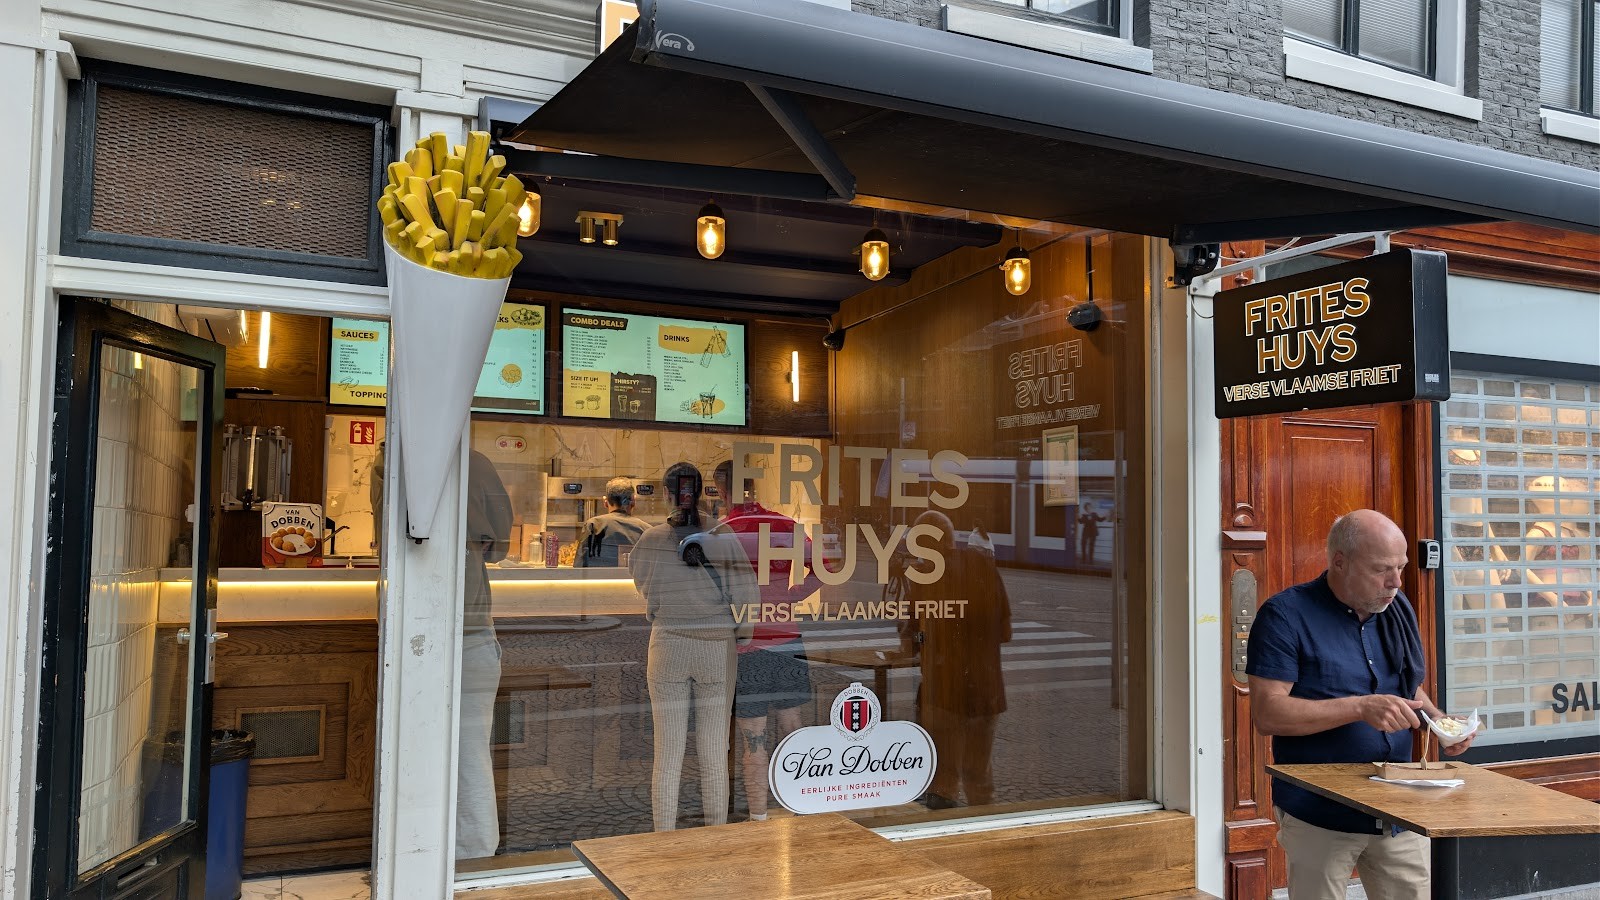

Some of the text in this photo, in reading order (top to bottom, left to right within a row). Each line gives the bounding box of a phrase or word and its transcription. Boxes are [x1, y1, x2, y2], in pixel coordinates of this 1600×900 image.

[655, 29, 683, 50] Vera
[1244, 277, 1371, 337] FRITES
[570, 316, 625, 328] COMBO DEALS
[340, 330, 375, 340] SAUCES
[663, 334, 690, 343] DRINKS
[1257, 323, 1358, 374] HUYS
[1223, 363, 1402, 402] VERSE VLAAMSE FRIET
[731, 441, 970, 510] FRITES
[270, 516, 315, 530] DOBBEN
[757, 522, 946, 586] HUYS
[730, 599, 969, 624] VERSE VLAAMSE FRIET
[843, 687, 869, 697] DOBBEN
[1551, 681, 1600, 714] SAL
[782, 741, 924, 781] Van Dobben
[801, 779, 908, 795] EERLIJKE INGREDIËNTEN
[826, 791, 881, 802] PURE SMAAK
